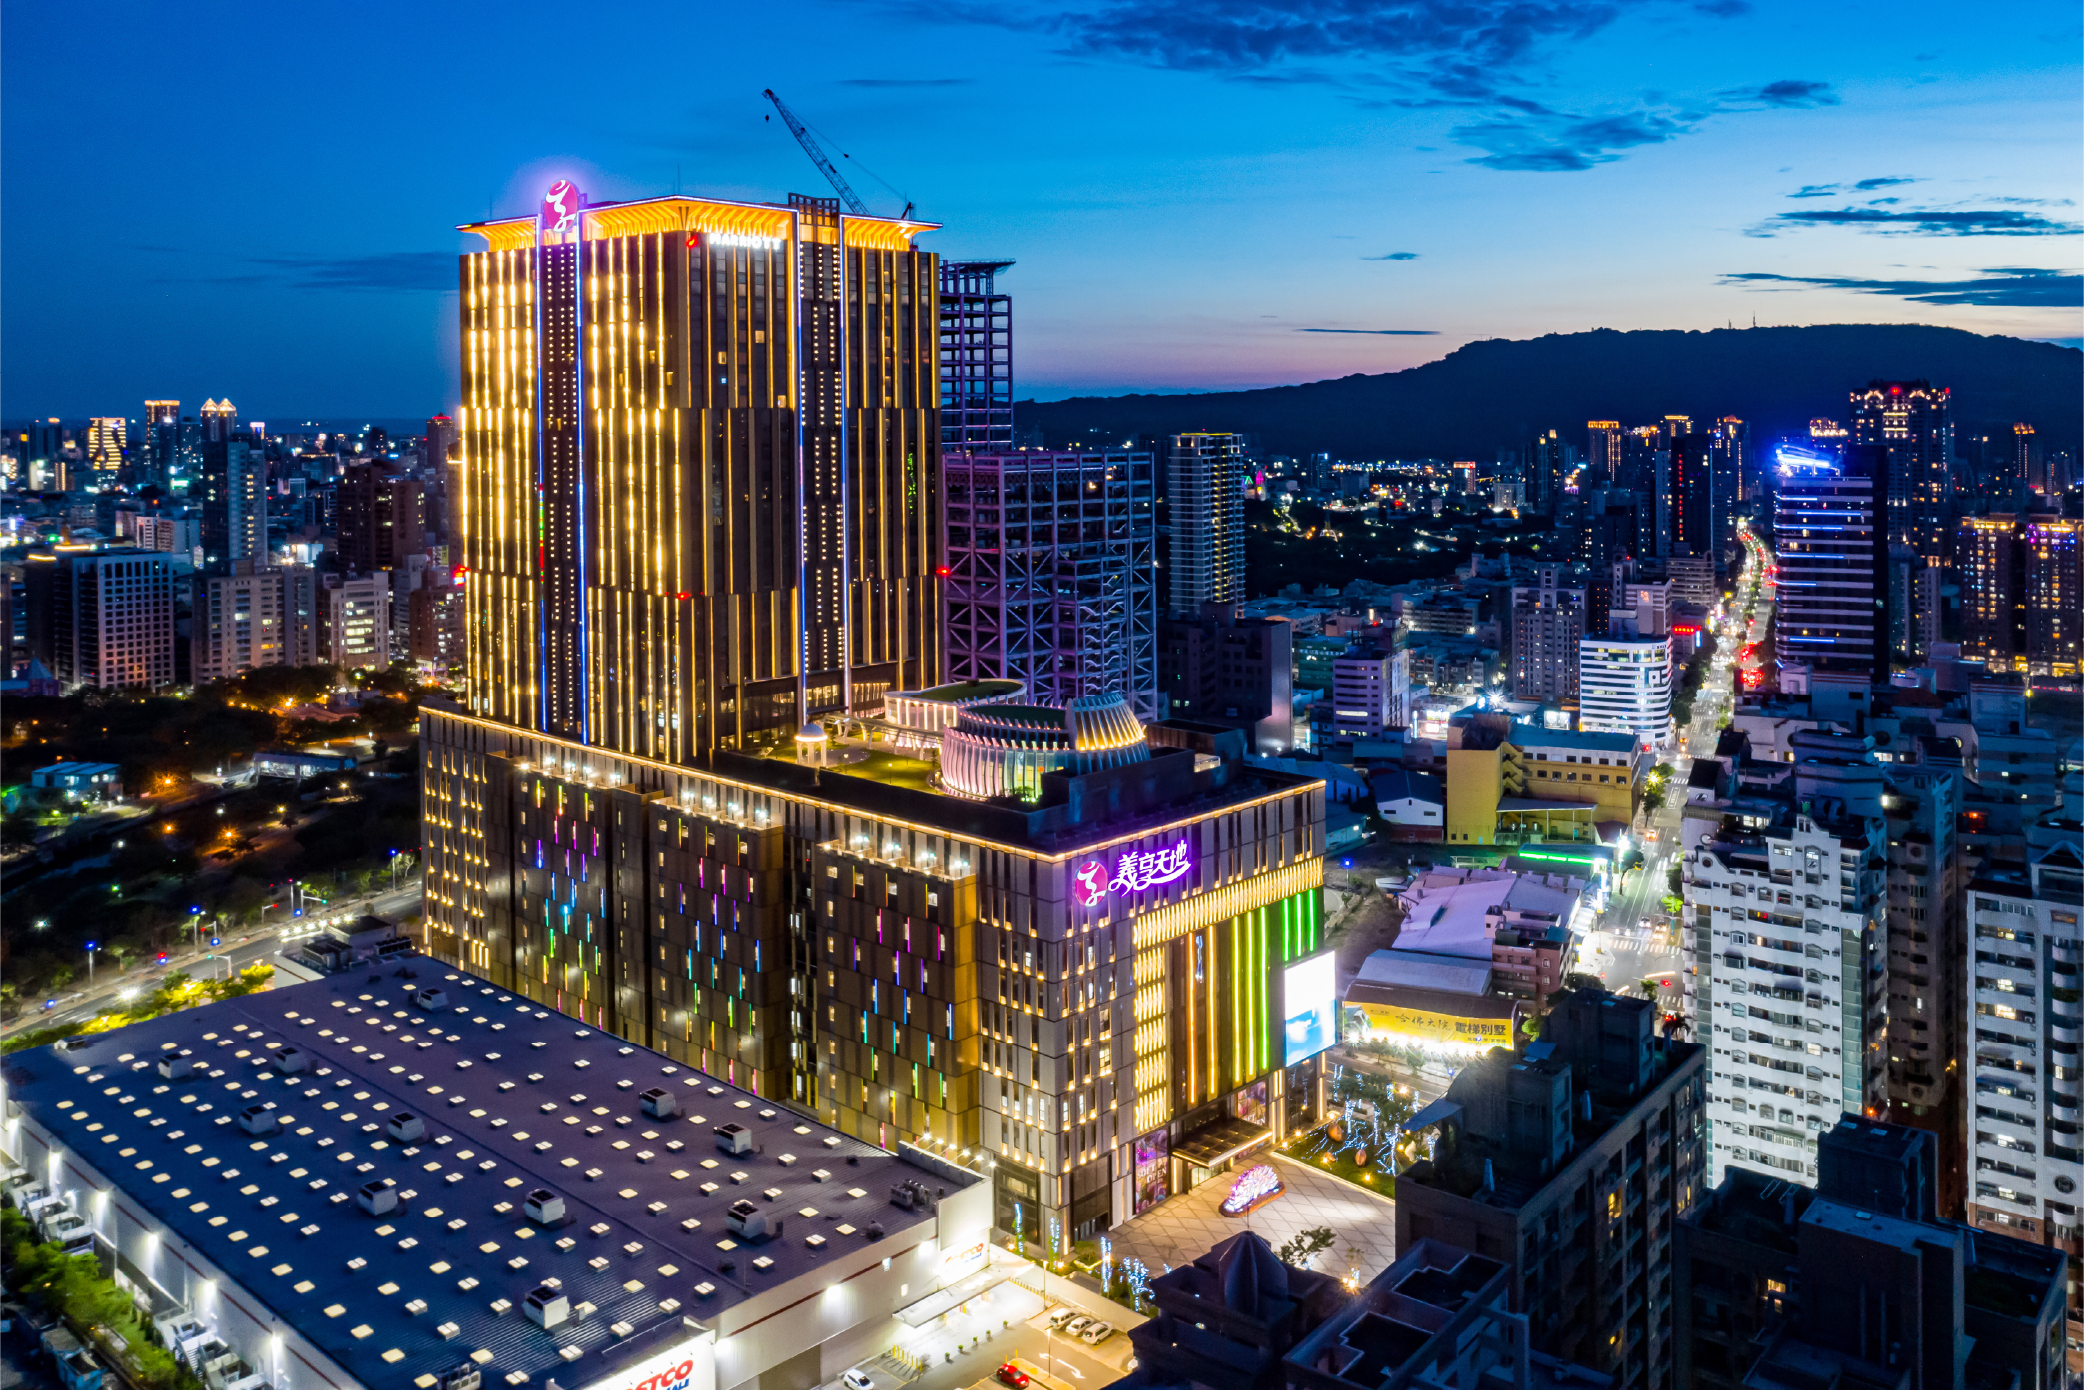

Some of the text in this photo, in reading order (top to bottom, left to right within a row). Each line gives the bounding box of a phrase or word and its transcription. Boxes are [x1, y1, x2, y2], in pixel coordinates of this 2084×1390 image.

[709, 233, 781, 250] MARRIOTT
[1108, 840, 1191, 897] 義享天地
[1455, 1021, 1506, 1035] 電梯別墅
[1137, 1164, 1155, 1180] SOFT
[1147, 1168, 1167, 1183] OPEN
[626, 1360, 694, 1390] STCO
